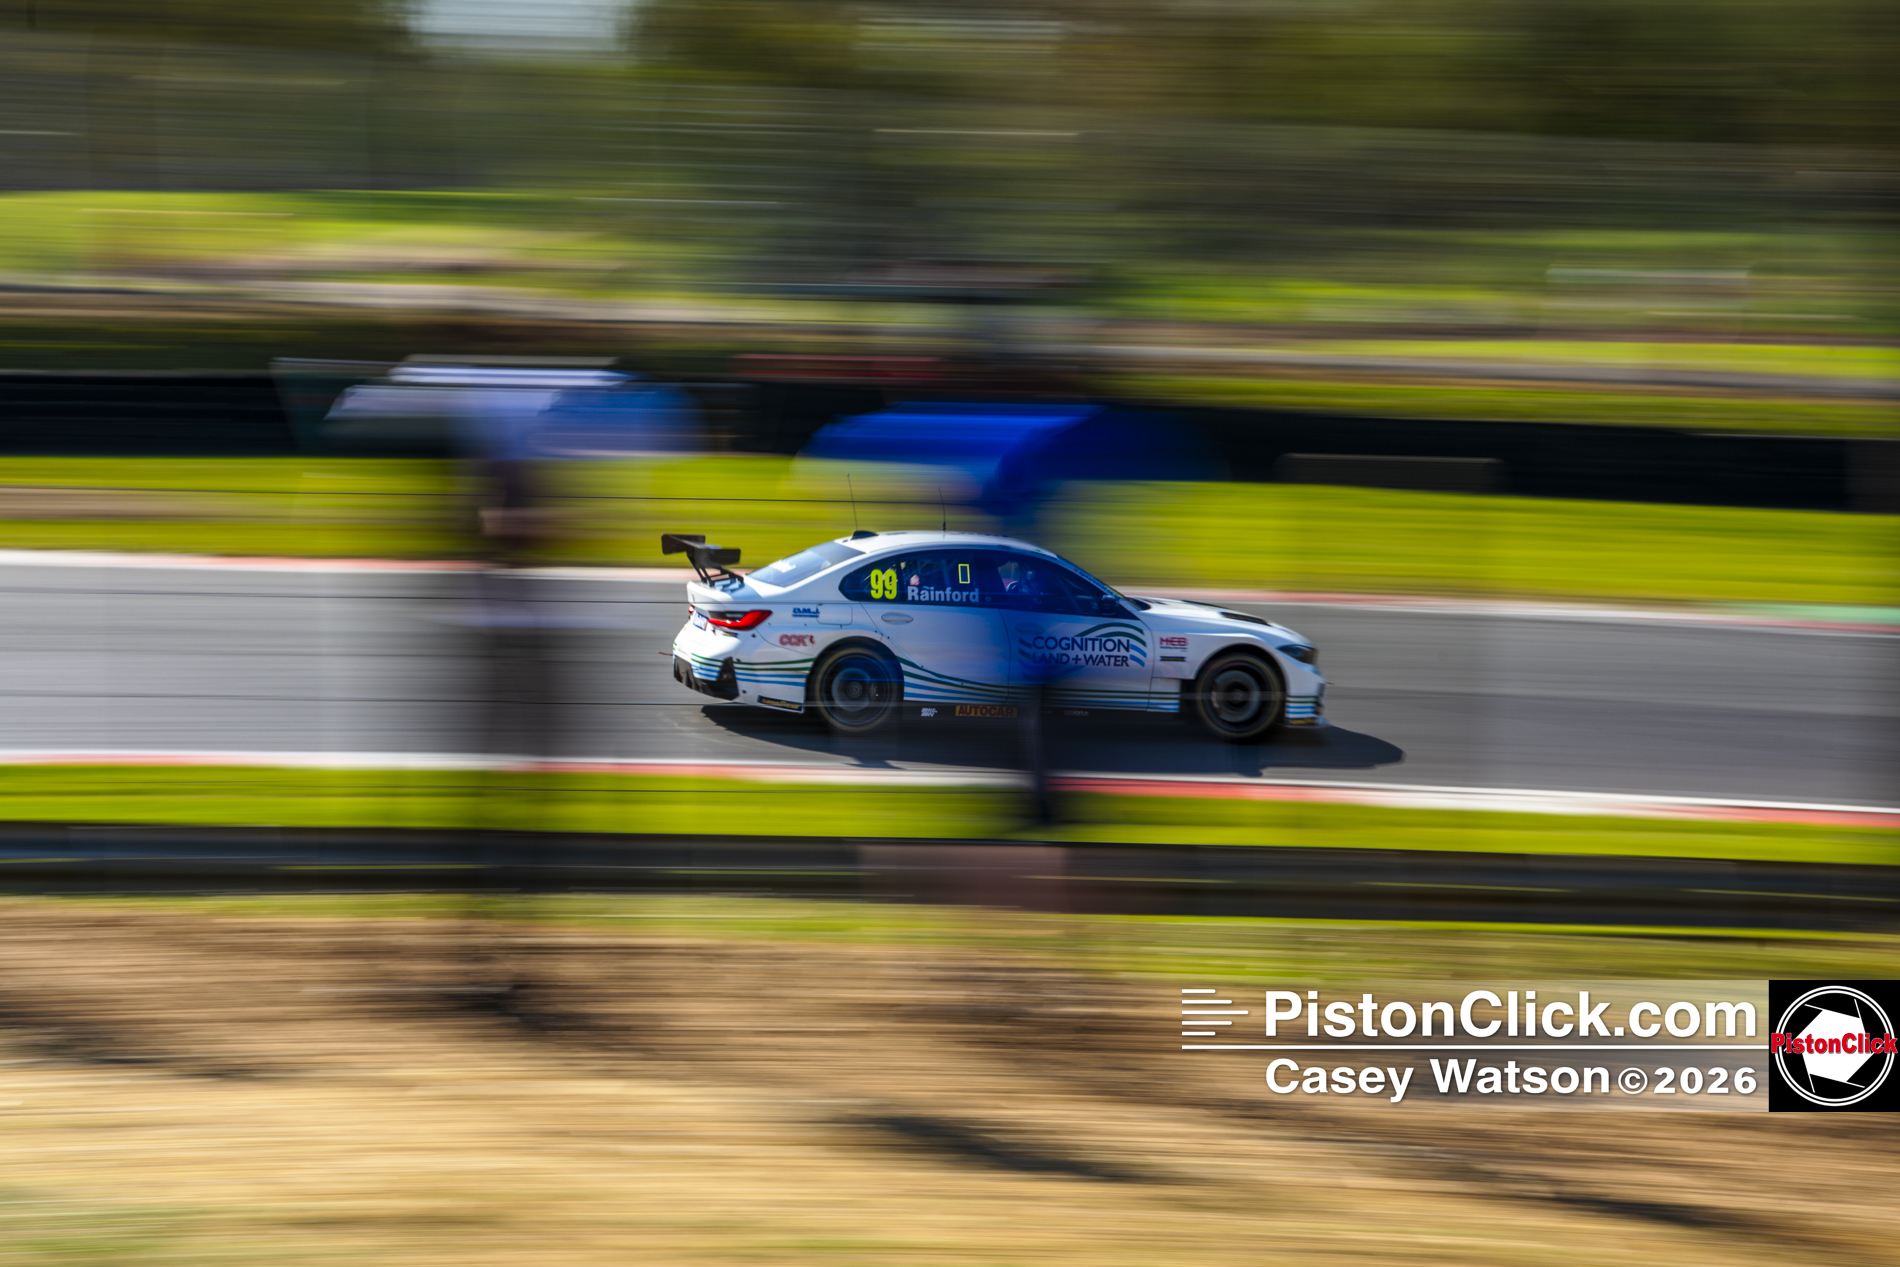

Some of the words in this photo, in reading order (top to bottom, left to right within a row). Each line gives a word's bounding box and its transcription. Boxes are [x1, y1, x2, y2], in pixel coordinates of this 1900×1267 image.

[870, 568, 897, 600] 99
[907, 585, 980, 603] Rainford
[1032, 636, 1130, 653] COGNITION
[958, 706, 1014, 717] AUTOCAR
